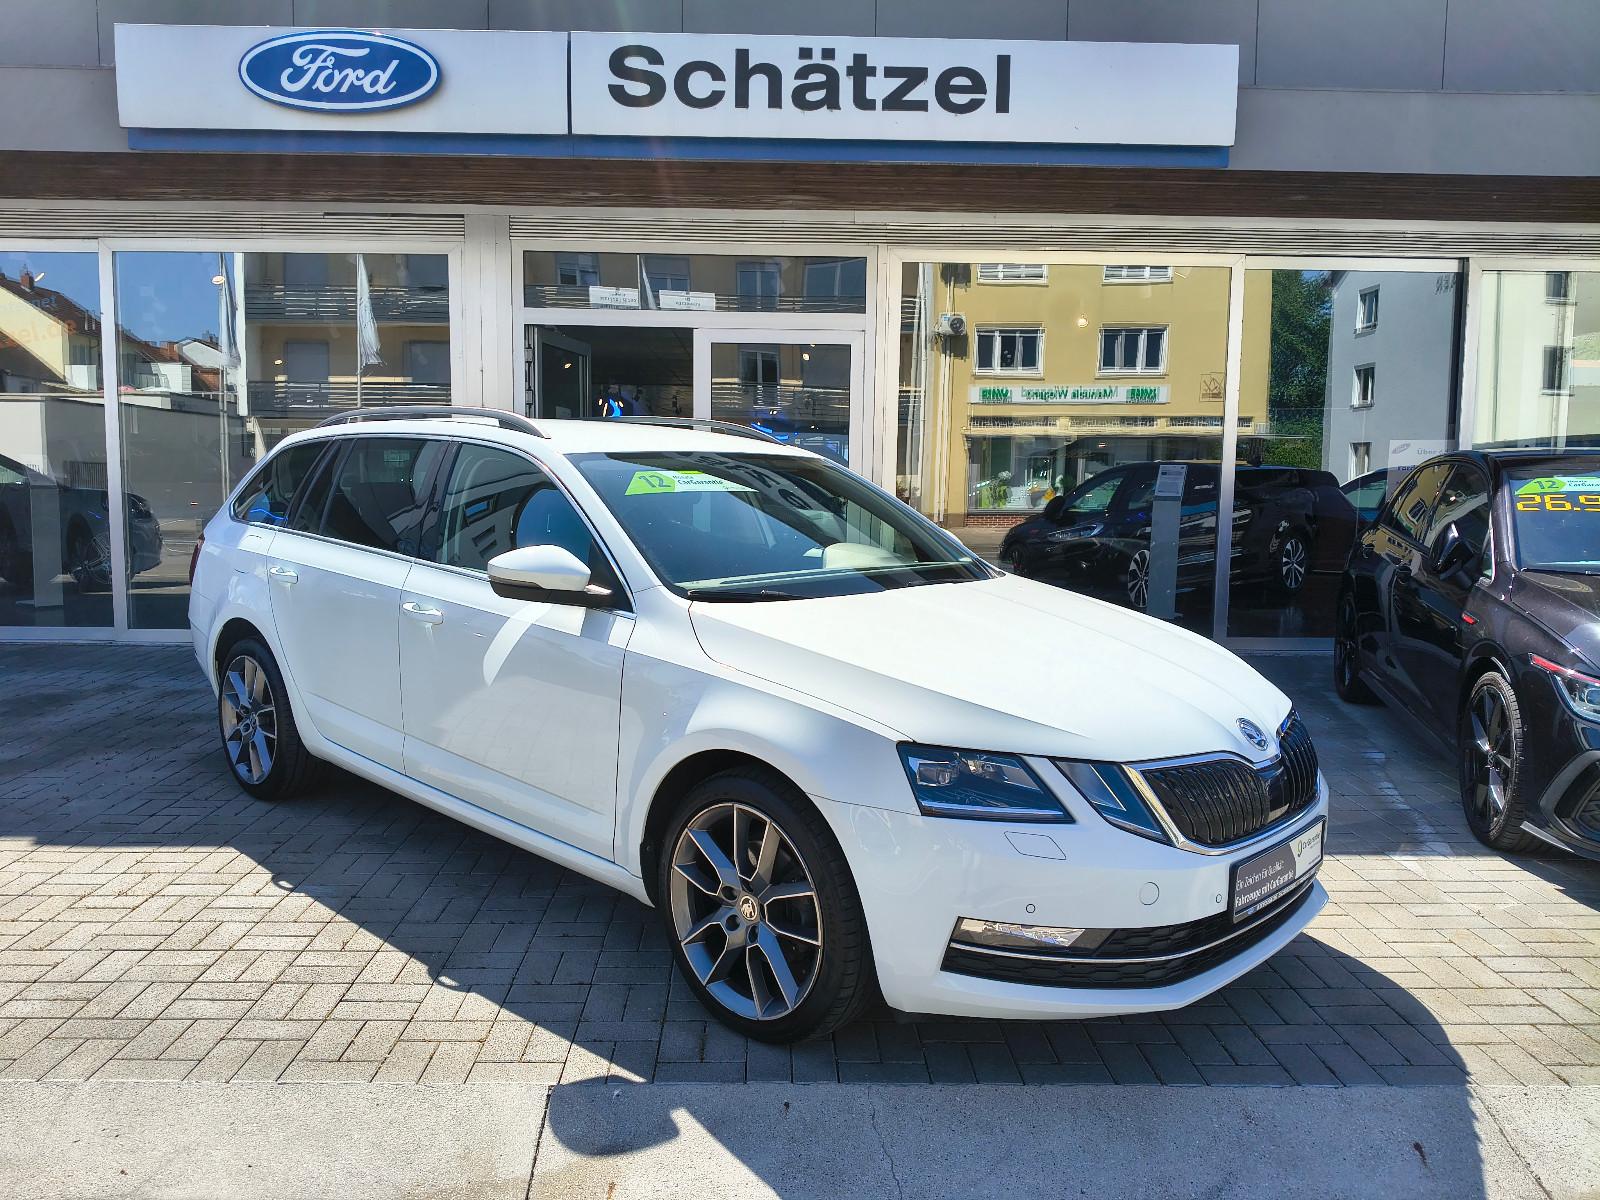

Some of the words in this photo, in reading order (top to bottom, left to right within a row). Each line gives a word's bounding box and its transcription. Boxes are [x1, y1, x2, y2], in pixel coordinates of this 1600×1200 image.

[281, 45, 399, 95] Ford
[608, 45, 1011, 115] Schätzel
[638, 474, 671, 488] 12
[1533, 480, 1560, 489] 12
